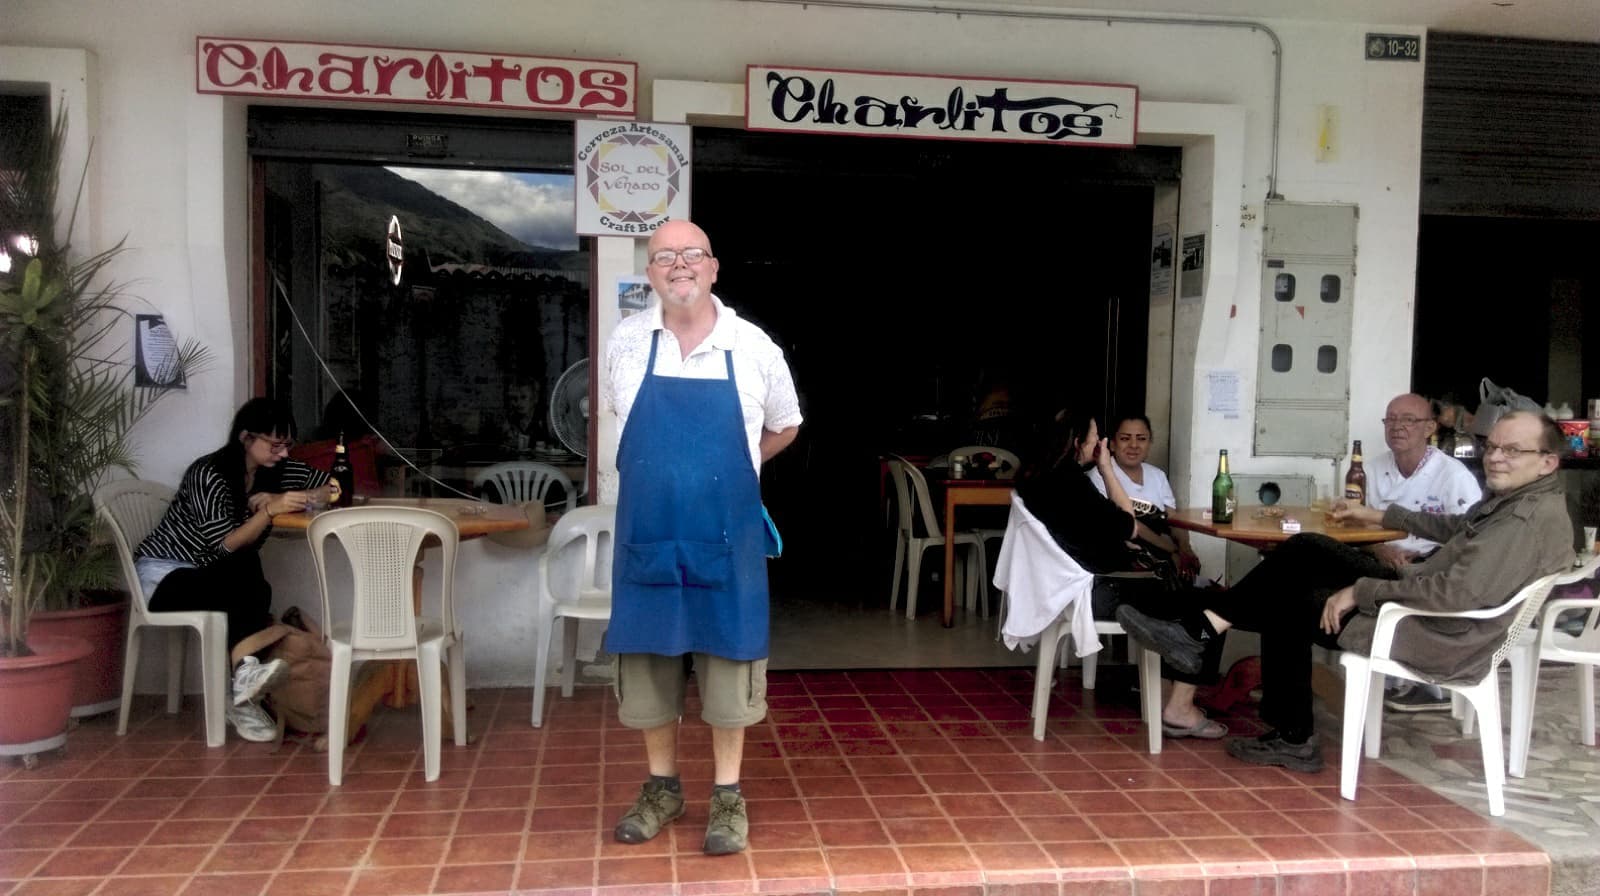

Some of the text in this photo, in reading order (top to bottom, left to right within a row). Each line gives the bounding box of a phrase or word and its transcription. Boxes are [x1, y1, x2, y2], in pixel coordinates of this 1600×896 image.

[1387, 40, 1417, 56] 10-32
[203, 42, 629, 107] Charlitos
[766, 71, 1121, 140] Charlitos
[578, 123, 689, 168] Cerveza Artesanal
[600, 216, 635, 232] Craft
